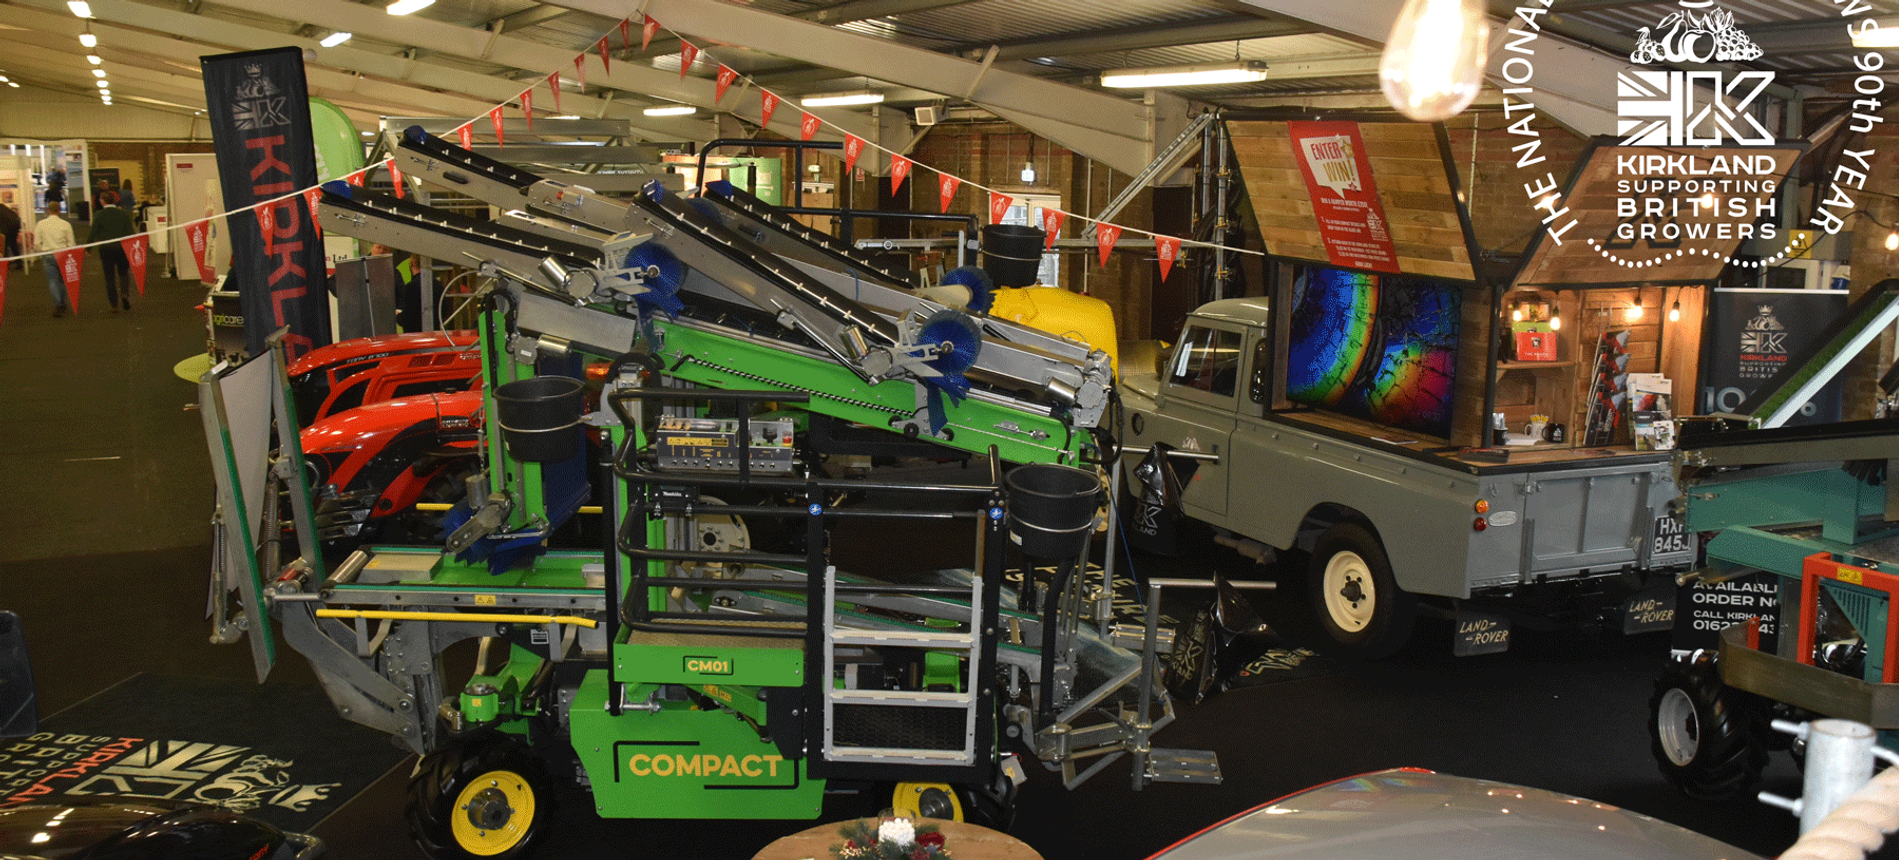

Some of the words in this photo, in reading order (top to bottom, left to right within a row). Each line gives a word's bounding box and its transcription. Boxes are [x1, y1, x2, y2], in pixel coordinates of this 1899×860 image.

[1310, 142, 1343, 160] ENTER
[1322, 160, 1356, 182] WIN!
[1739, 354, 1787, 362] KIRKLAND
[1654, 534, 1691, 553] 845J
[1692, 592, 1755, 606] ORDER
[1693, 609, 1724, 619] CALL
[687, 659, 729, 673] CM01
[628, 753, 783, 777] COMPACT
